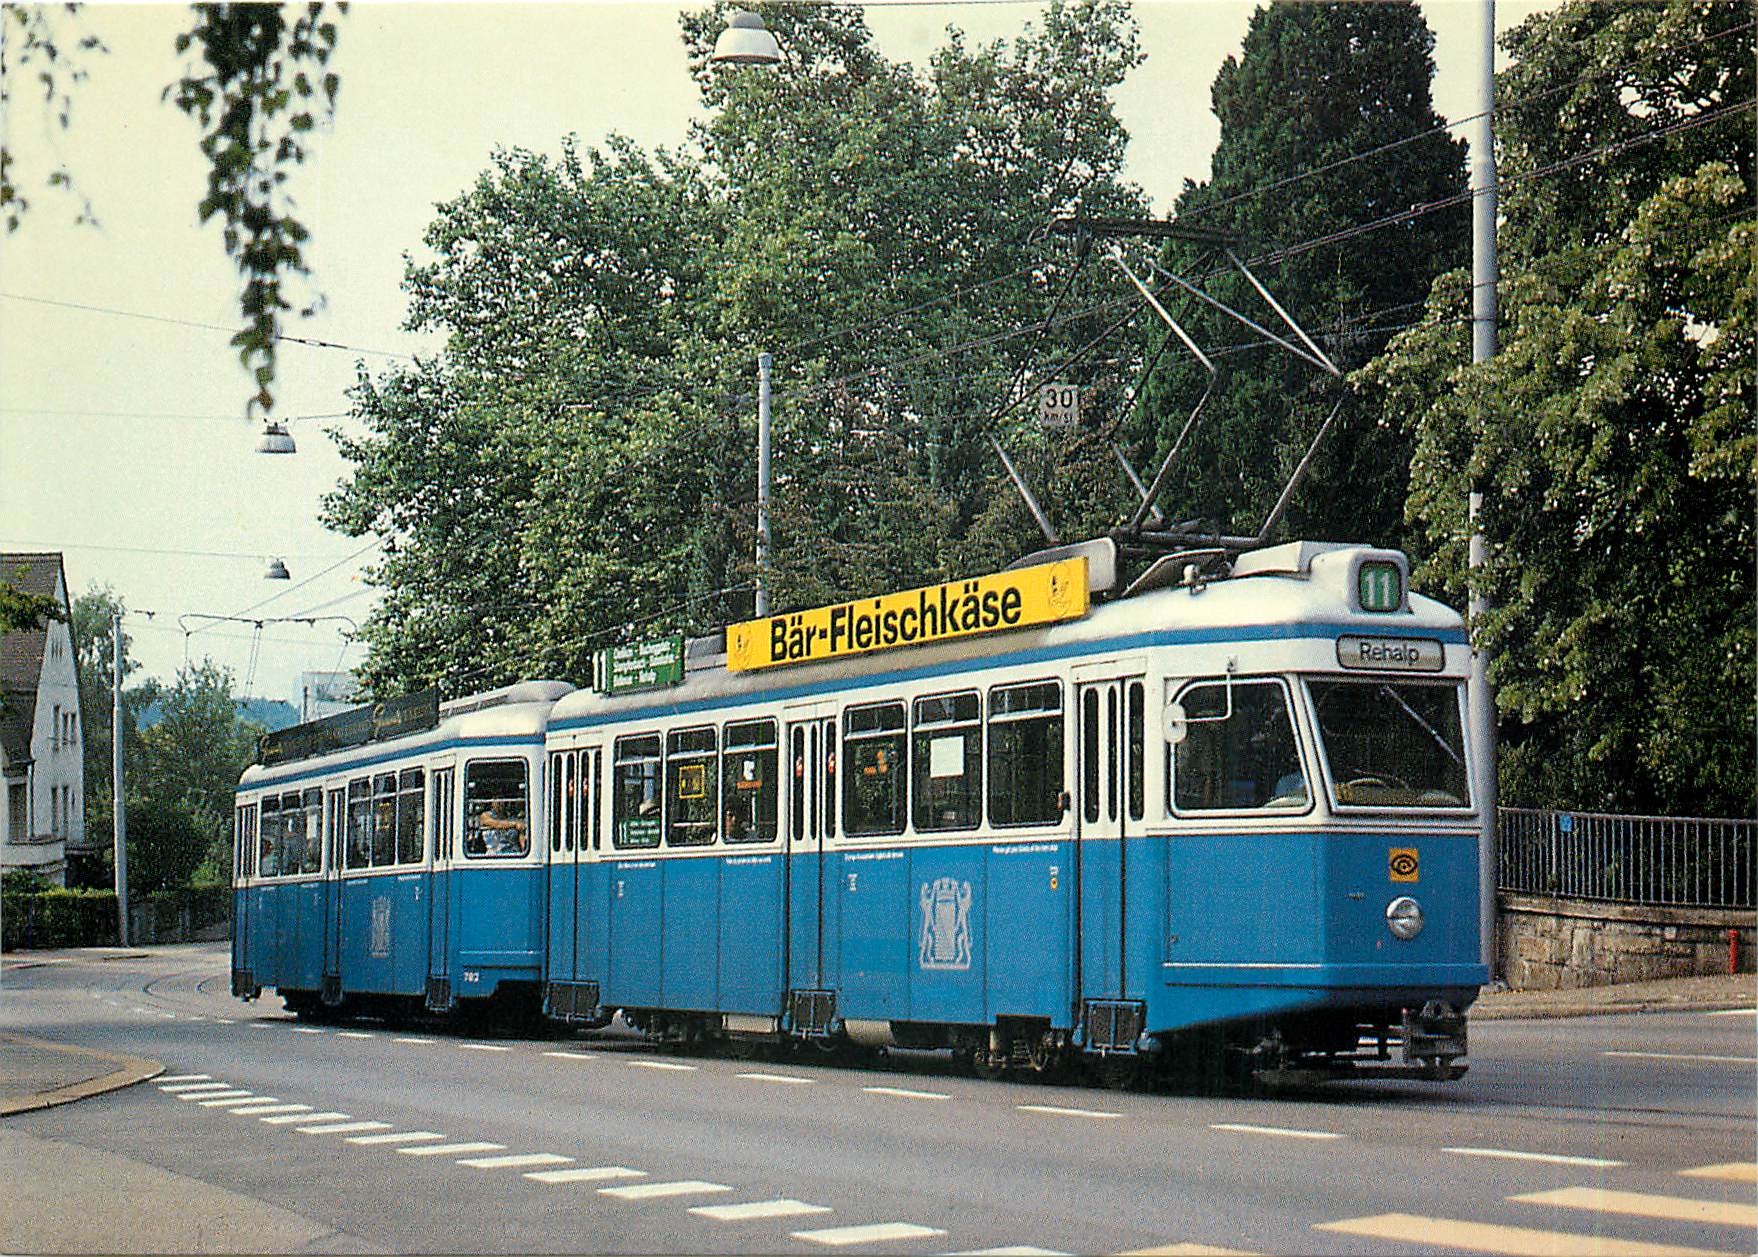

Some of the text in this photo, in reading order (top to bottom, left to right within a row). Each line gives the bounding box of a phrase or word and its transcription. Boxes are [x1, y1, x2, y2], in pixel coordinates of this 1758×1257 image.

[1046, 388, 1073, 408] 30
[1364, 570, 1390, 607] 11
[770, 582, 1022, 662] Bär-Fleischkäse
[592, 650, 607, 691] 11
[1360, 642, 1420, 666] Rehalp
